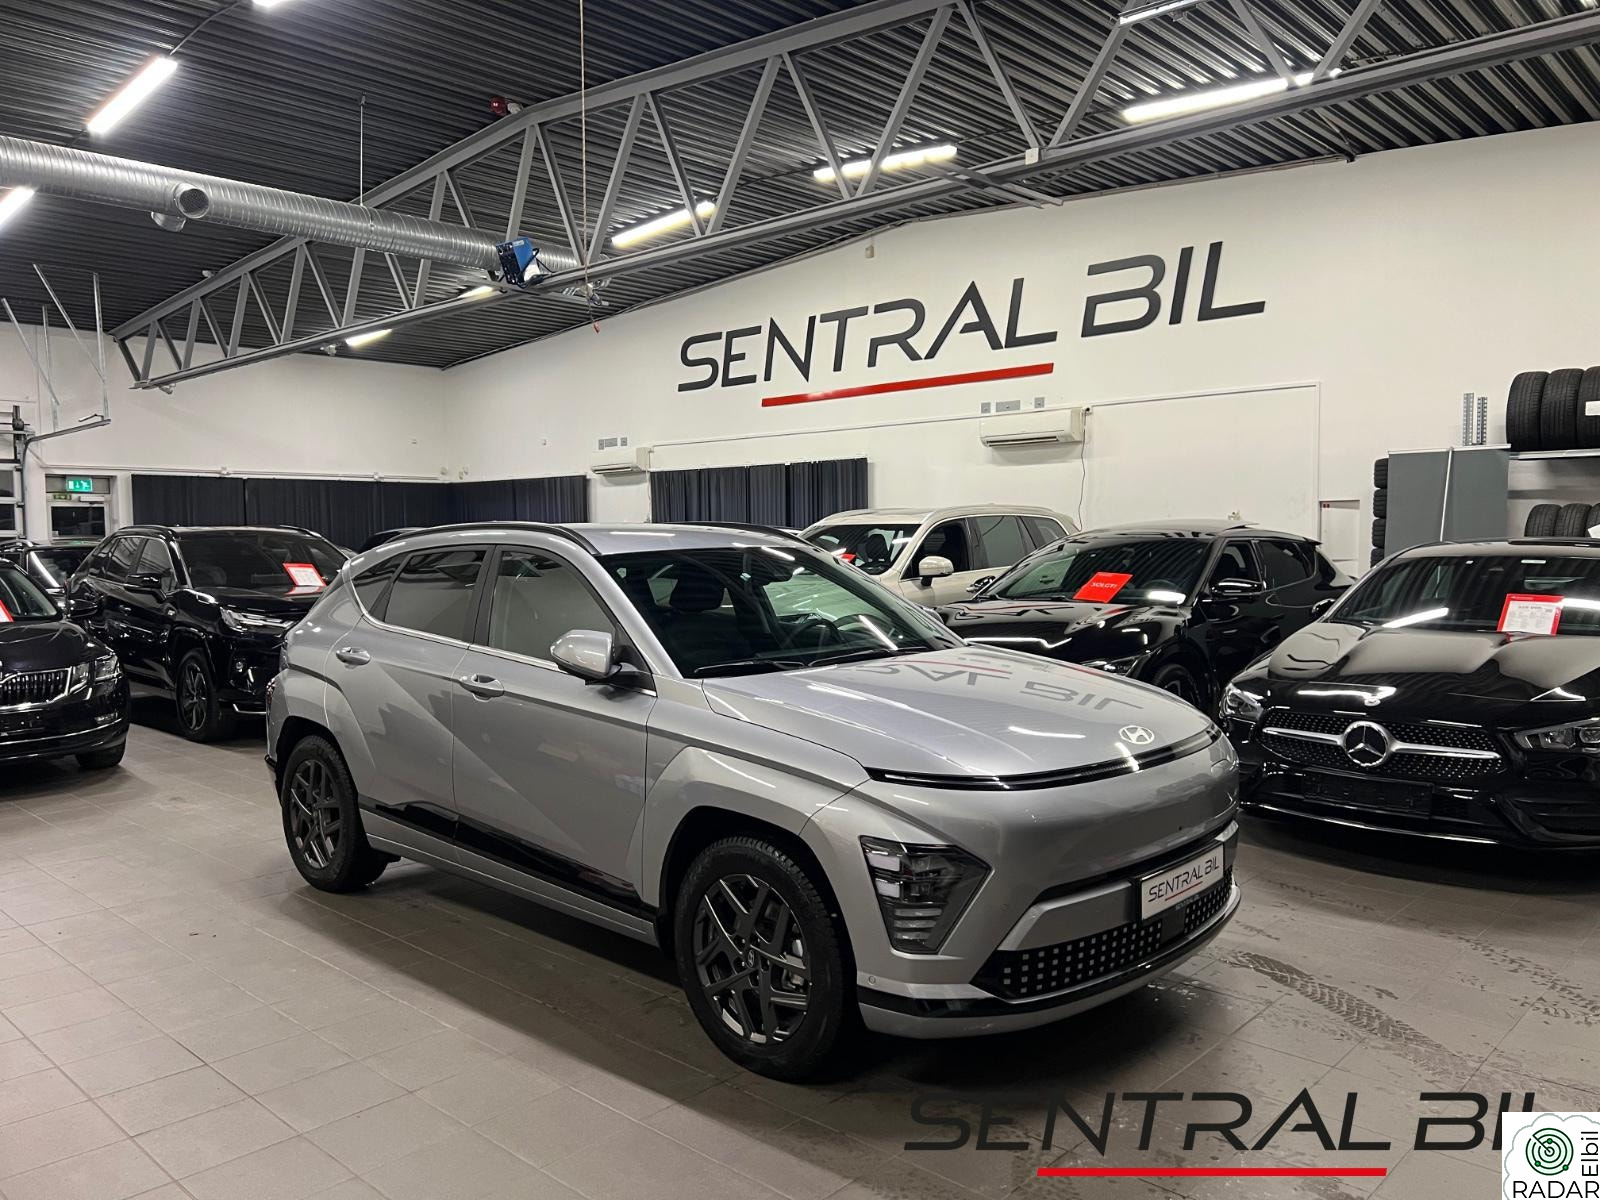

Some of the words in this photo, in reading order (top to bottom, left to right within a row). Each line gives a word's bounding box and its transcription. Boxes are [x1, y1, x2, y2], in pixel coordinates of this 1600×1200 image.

[677, 277, 1058, 392] SENTRAL
[1081, 241, 1266, 338] BIL
[1148, 865, 1203, 902] SENTRAL
[1204, 856, 1219, 875] BIL
